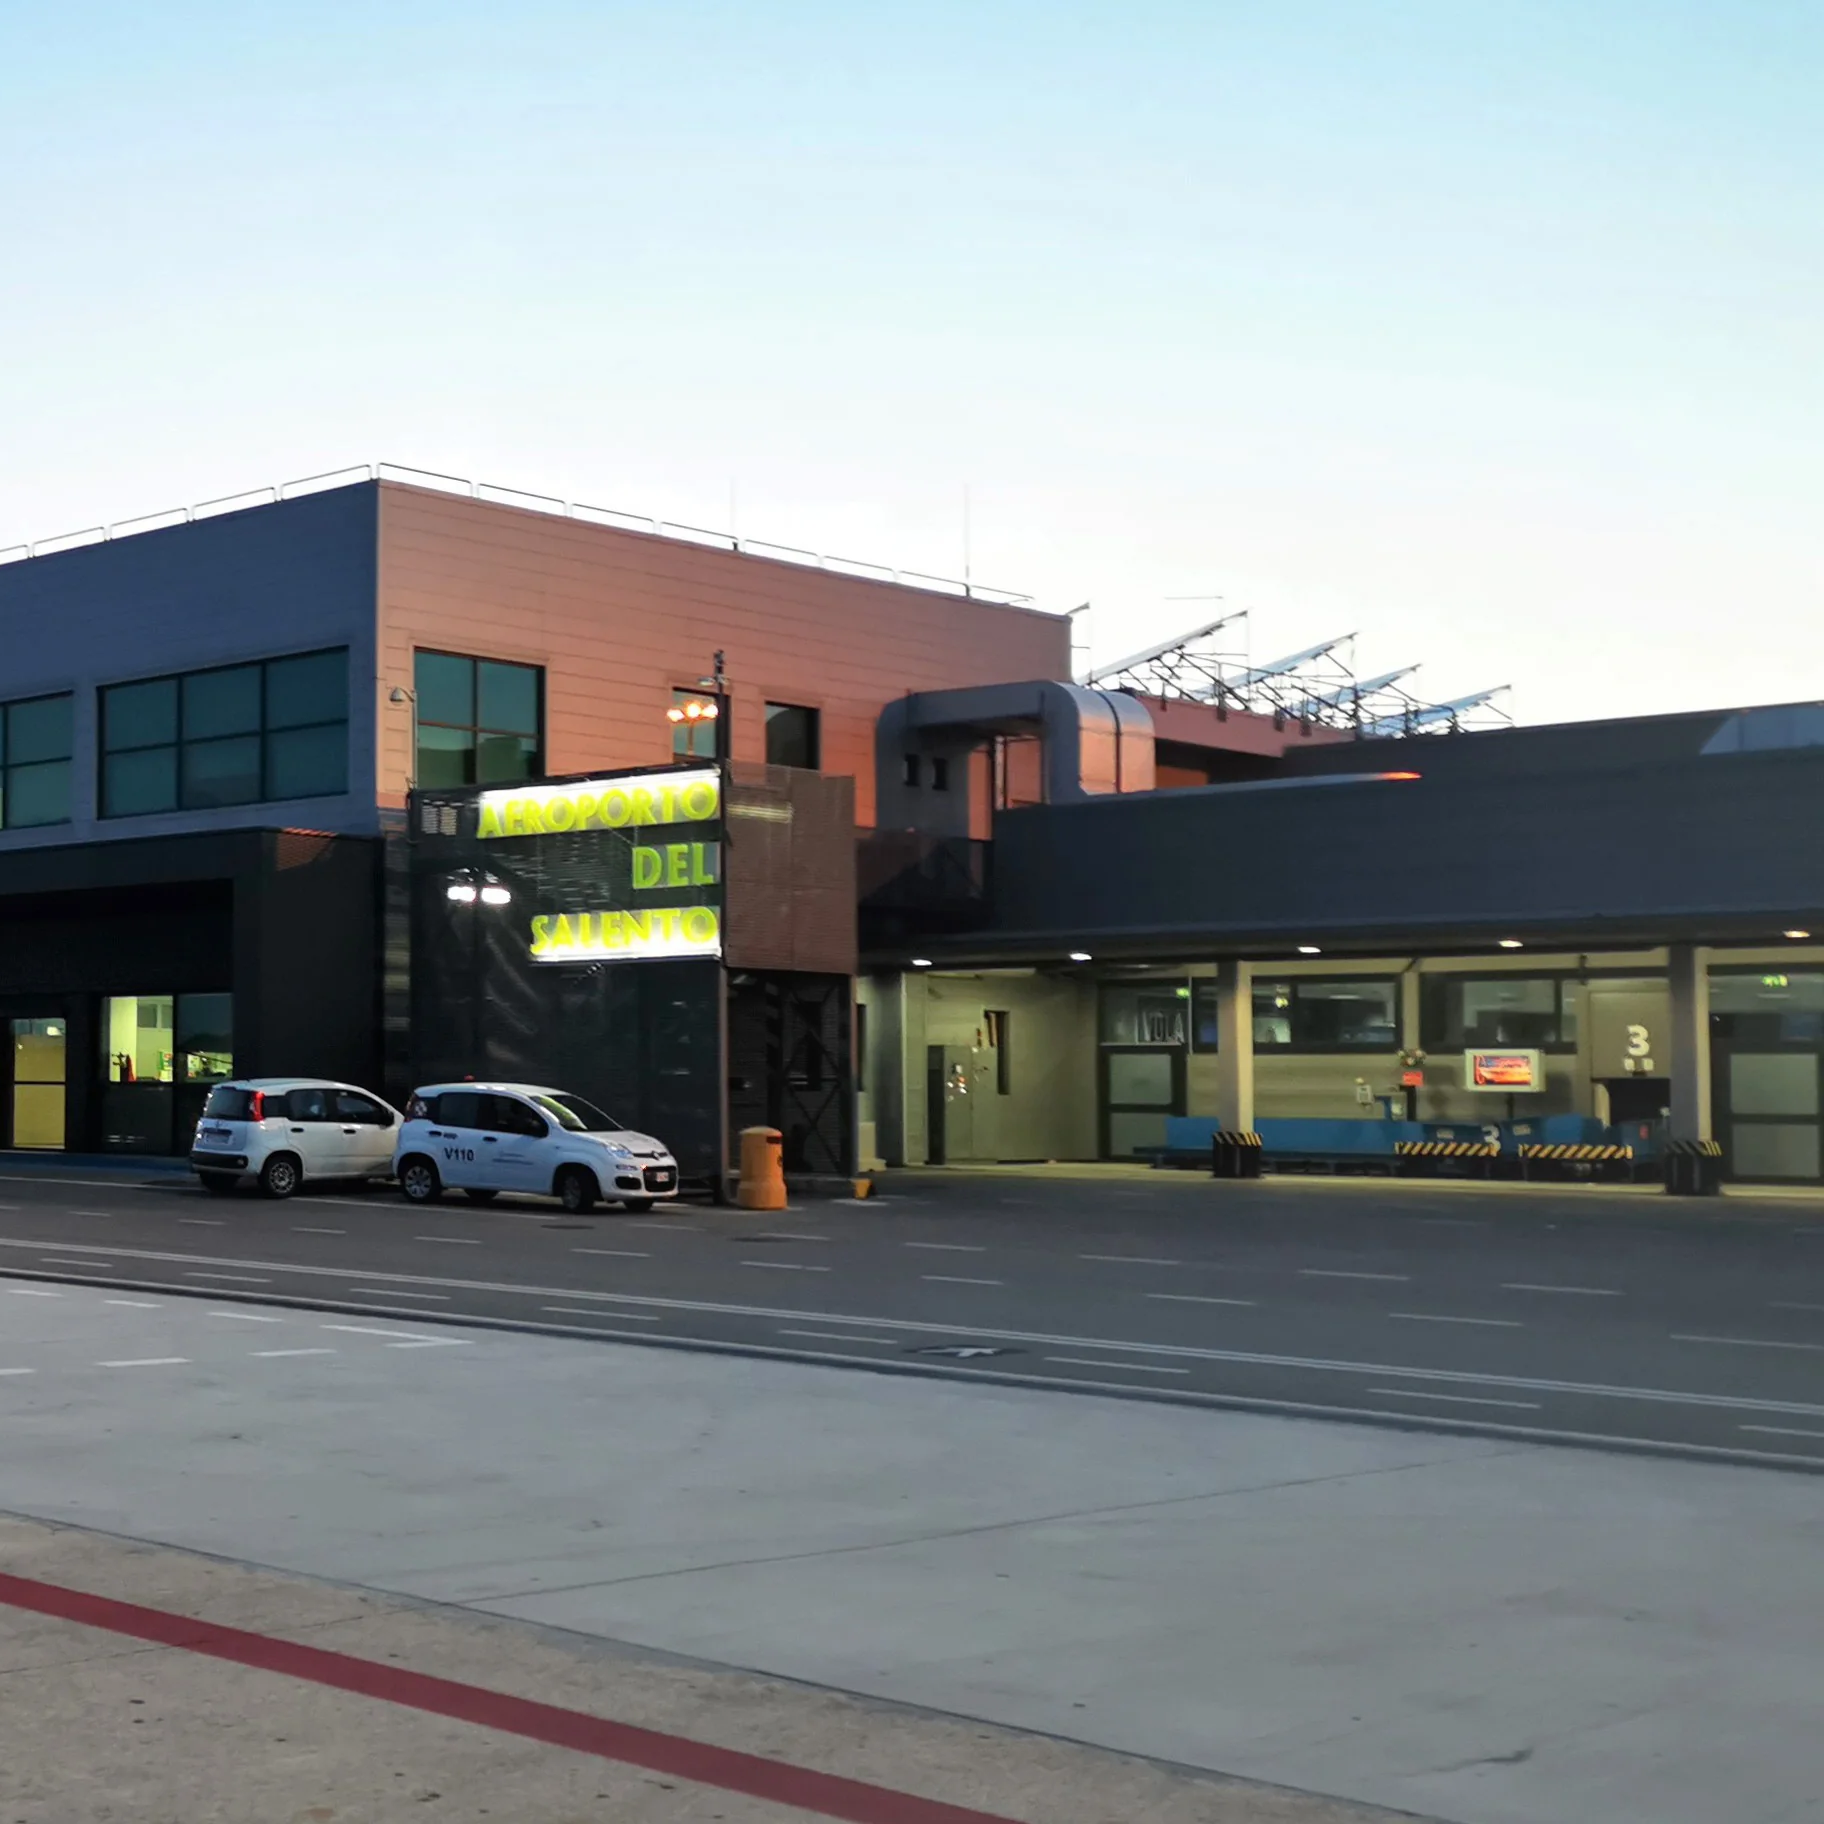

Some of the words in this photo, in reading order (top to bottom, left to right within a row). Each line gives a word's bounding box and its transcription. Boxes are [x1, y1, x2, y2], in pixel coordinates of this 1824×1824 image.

[477, 781, 717, 838] AEROPORTO
[633, 843, 714, 889] DEL
[530, 906, 718, 955] SALENTO
[1627, 1024, 1650, 1056] 3
[444, 1147, 475, 1161] V110
